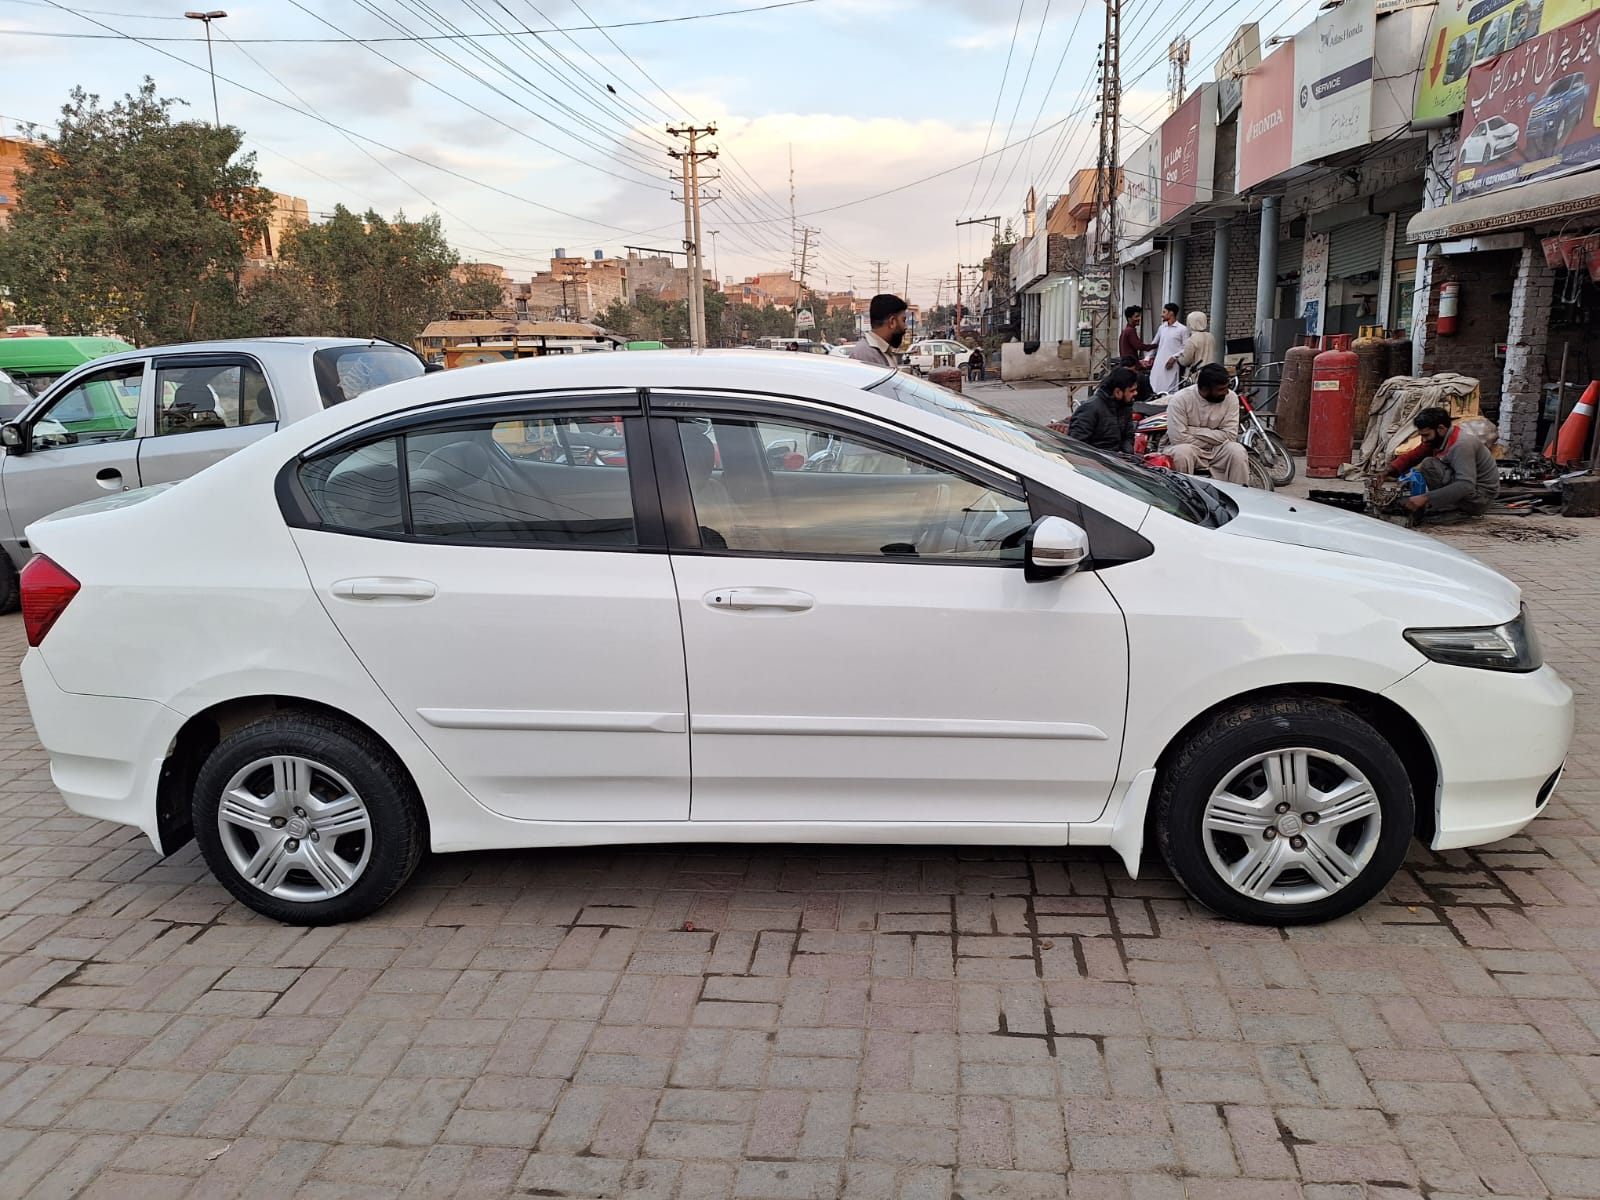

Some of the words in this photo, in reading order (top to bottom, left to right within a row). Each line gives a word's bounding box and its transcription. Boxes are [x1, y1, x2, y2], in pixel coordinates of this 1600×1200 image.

[1343, 23, 1363, 41] Honda
[1315, 77, 1341, 95] SERVICE
[1252, 109, 1283, 139] HONDA
[1170, 146, 1182, 166] Lube
[1166, 169, 1178, 187] Shop
